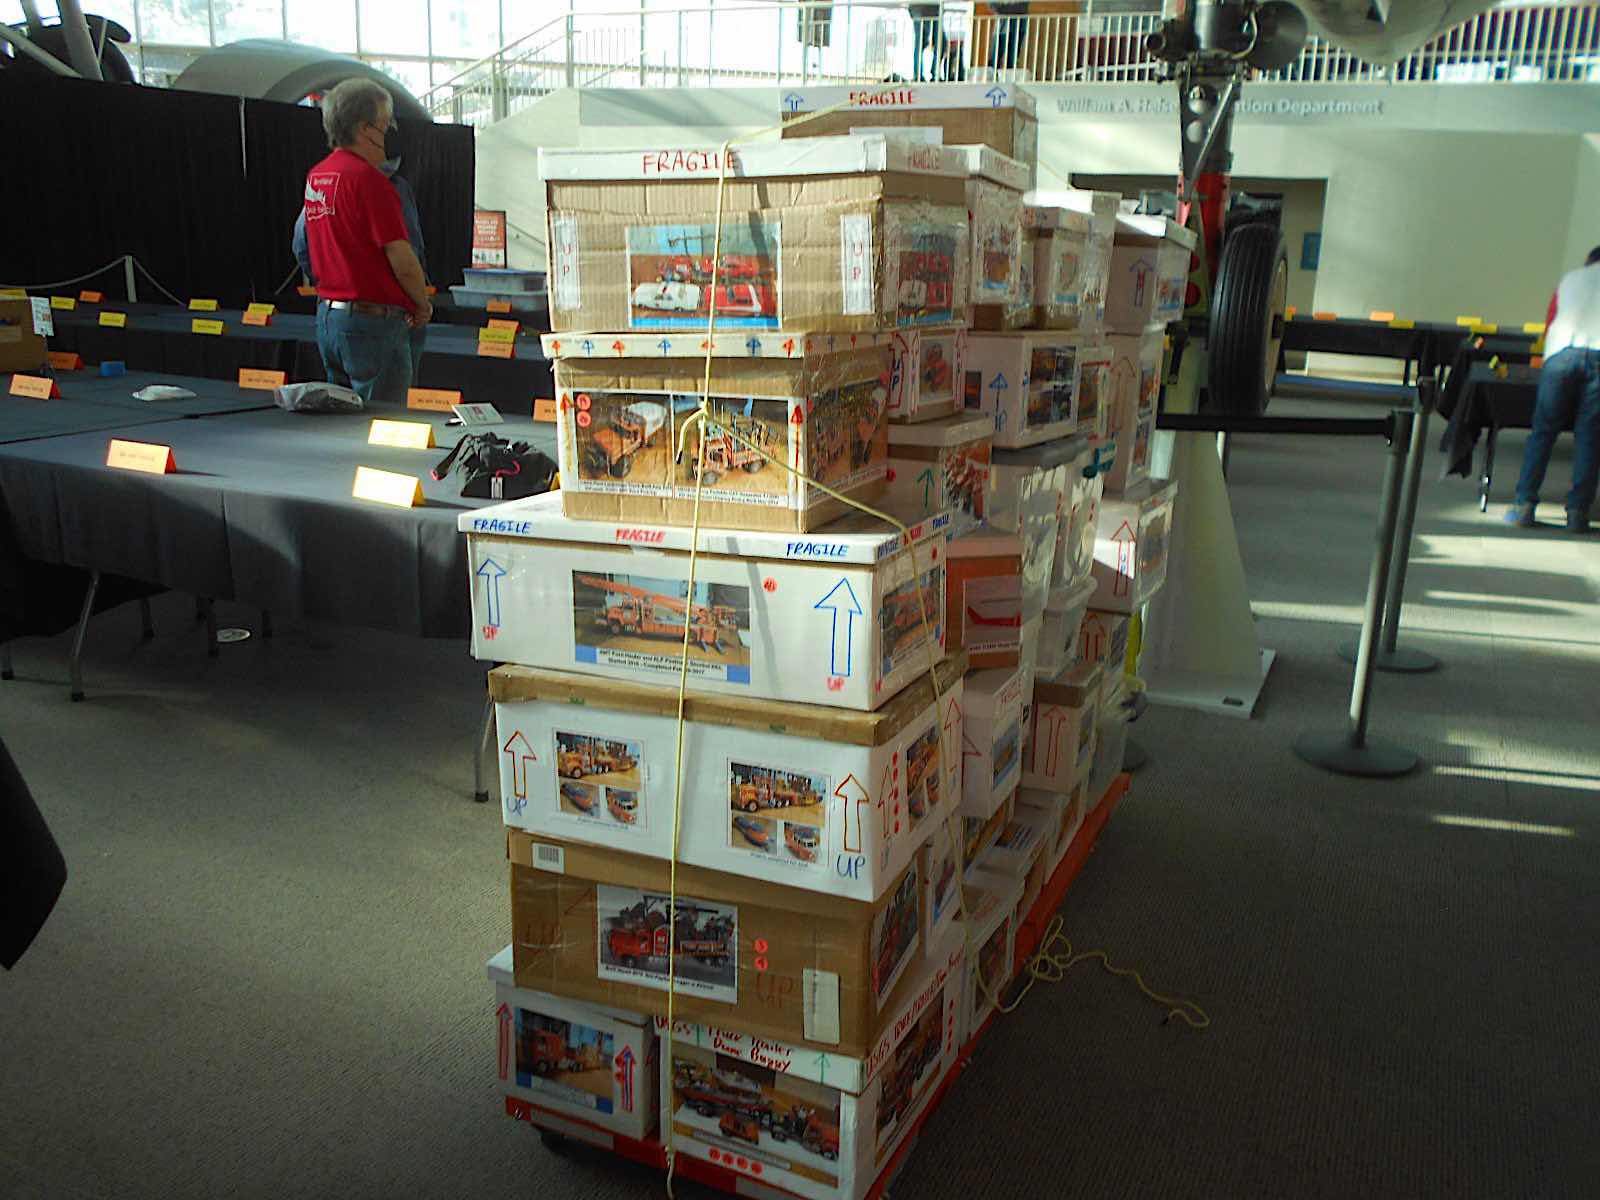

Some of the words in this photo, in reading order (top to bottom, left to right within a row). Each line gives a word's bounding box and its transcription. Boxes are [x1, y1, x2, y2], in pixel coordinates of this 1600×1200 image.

[1057, 98, 1114, 113] William
[1280, 98, 1385, 117] Department
[642, 150, 742, 174] FRAGILE
[473, 518, 533, 534] FRAGILE
[615, 528, 666, 543] FRAGILE
[786, 541, 849, 557] FRAGILE
[826, 676, 845, 692] UP
[506, 796, 527, 817] UP
[836, 854, 866, 880] UP
